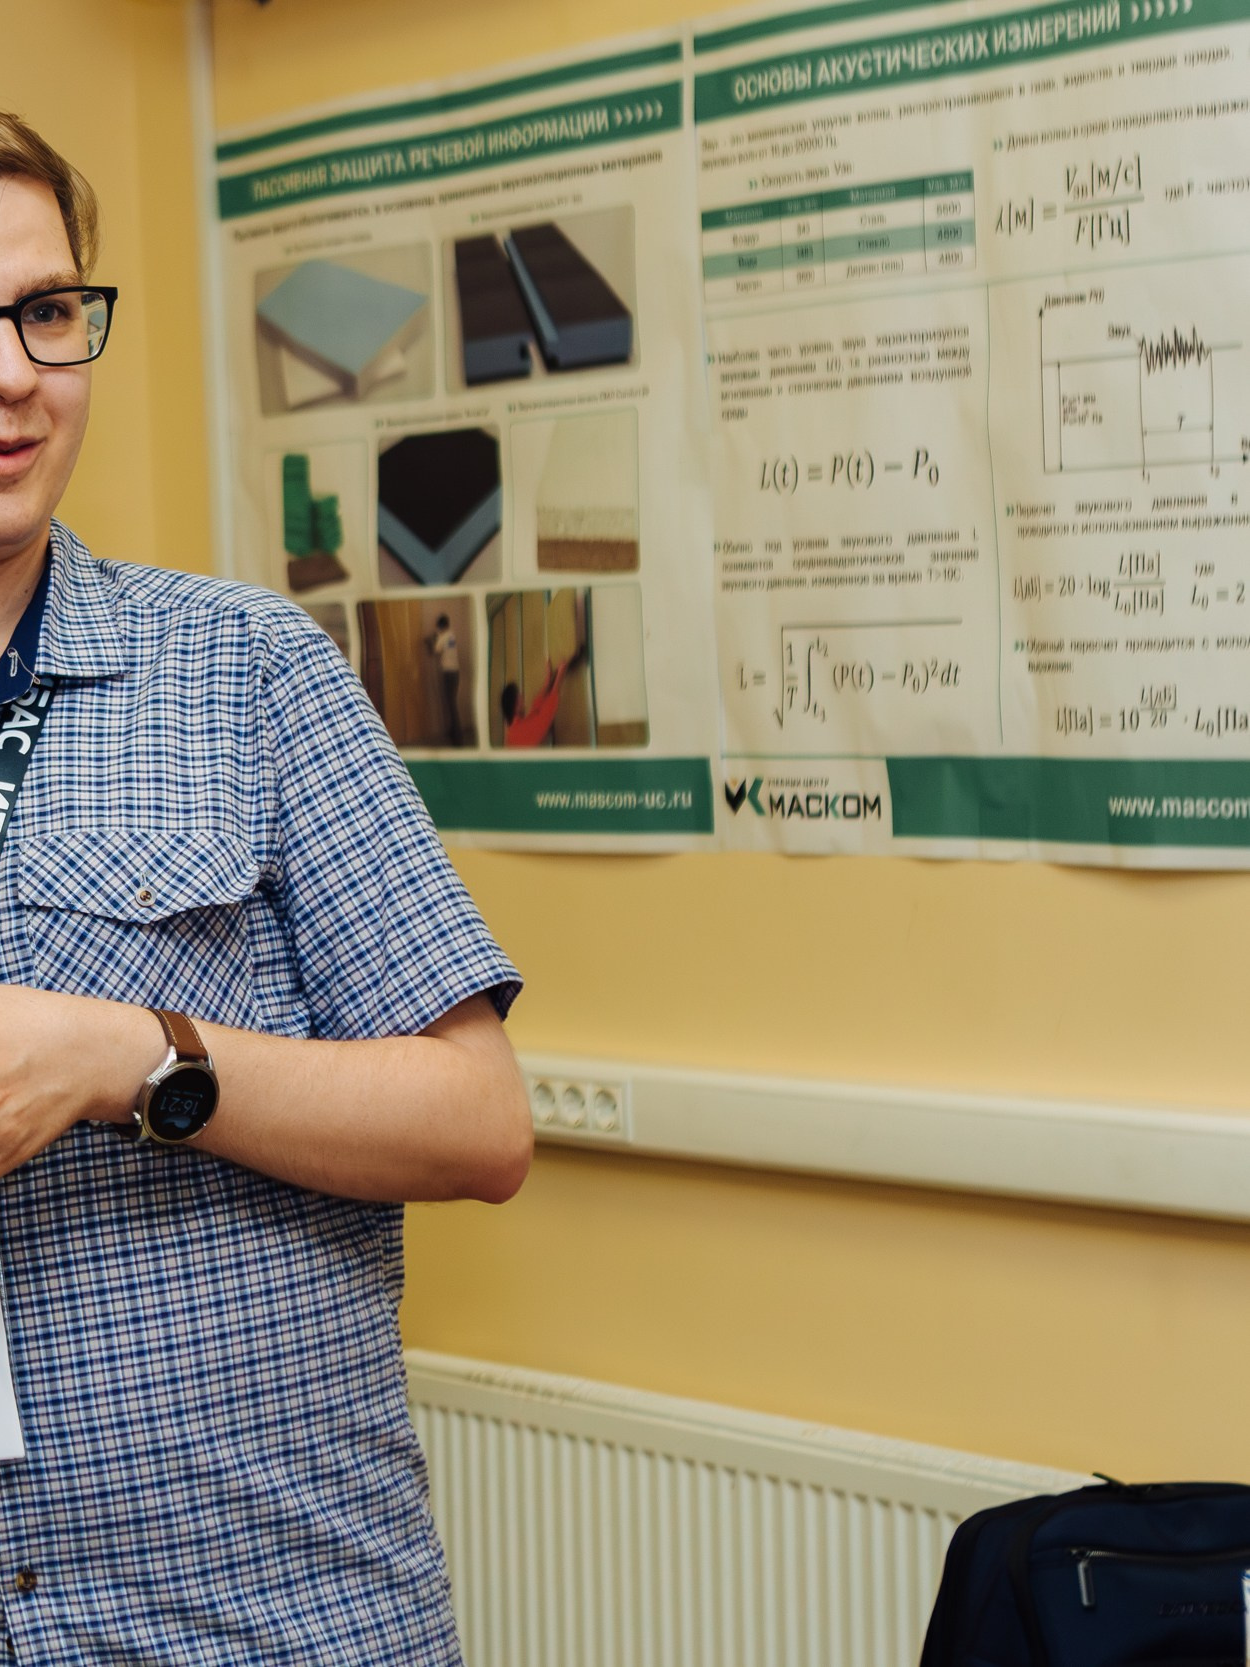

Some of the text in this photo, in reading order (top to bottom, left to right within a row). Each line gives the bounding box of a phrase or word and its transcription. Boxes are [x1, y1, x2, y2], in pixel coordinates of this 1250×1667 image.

[734, 0, 1121, 104] ОСНОВЫ АКУСТИЧЕСКИХ ИЗМЕРЕНИЙ
[253, 107, 610, 202] ПАССИВНАЯ ЗАЩИТА РЕЧЕВОЙ ИНФОРМАЦИИ
[760, 453, 799, 496] L(t)
[830, 448, 875, 490] P(t)
[1058, 575, 1076, 596] 20
[1088, 574, 1111, 604] log
[536, 789, 693, 810] www.mascom-uc.ru
[160, 1095, 200, 1116] 16:21
